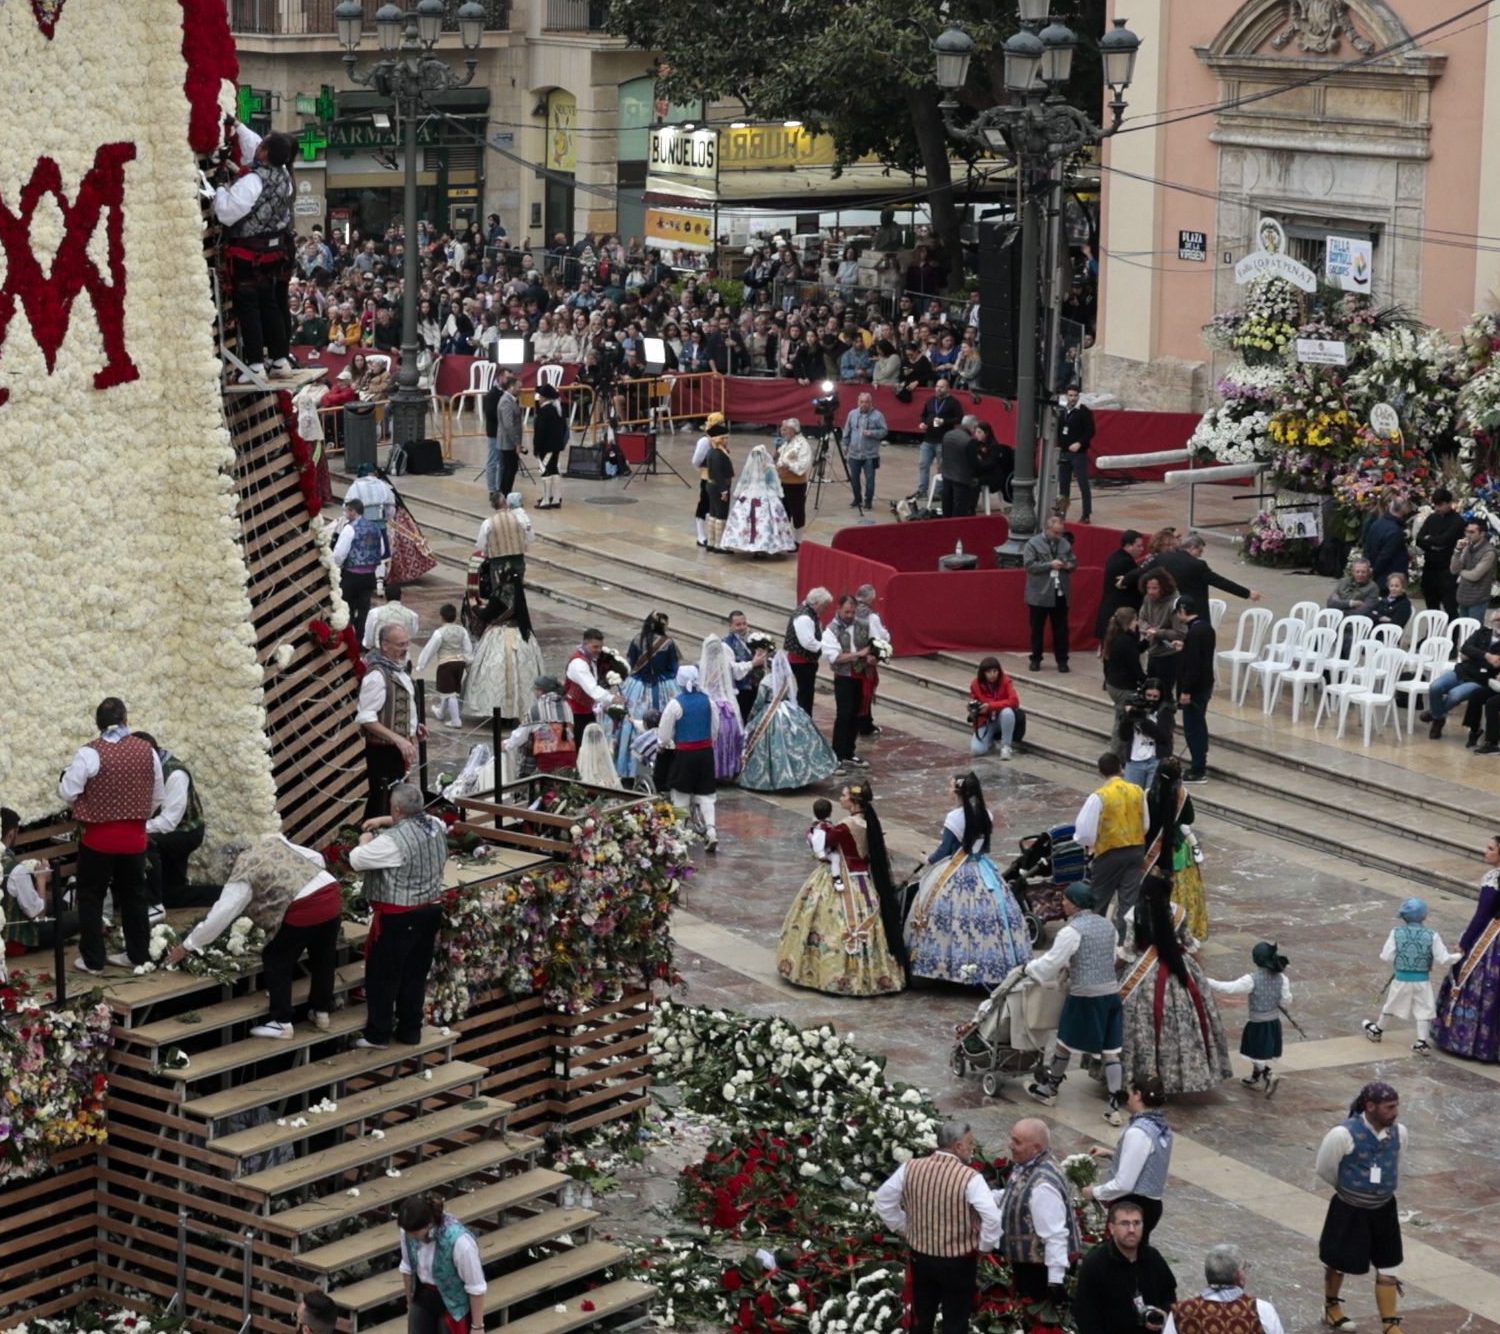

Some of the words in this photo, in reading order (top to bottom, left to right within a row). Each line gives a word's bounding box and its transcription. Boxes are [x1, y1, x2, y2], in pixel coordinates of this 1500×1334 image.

[328, 124, 430, 144] FARMAA
[1182, 231, 1203, 244] PLAZA
[1179, 248, 1206, 261] VIRGEN
